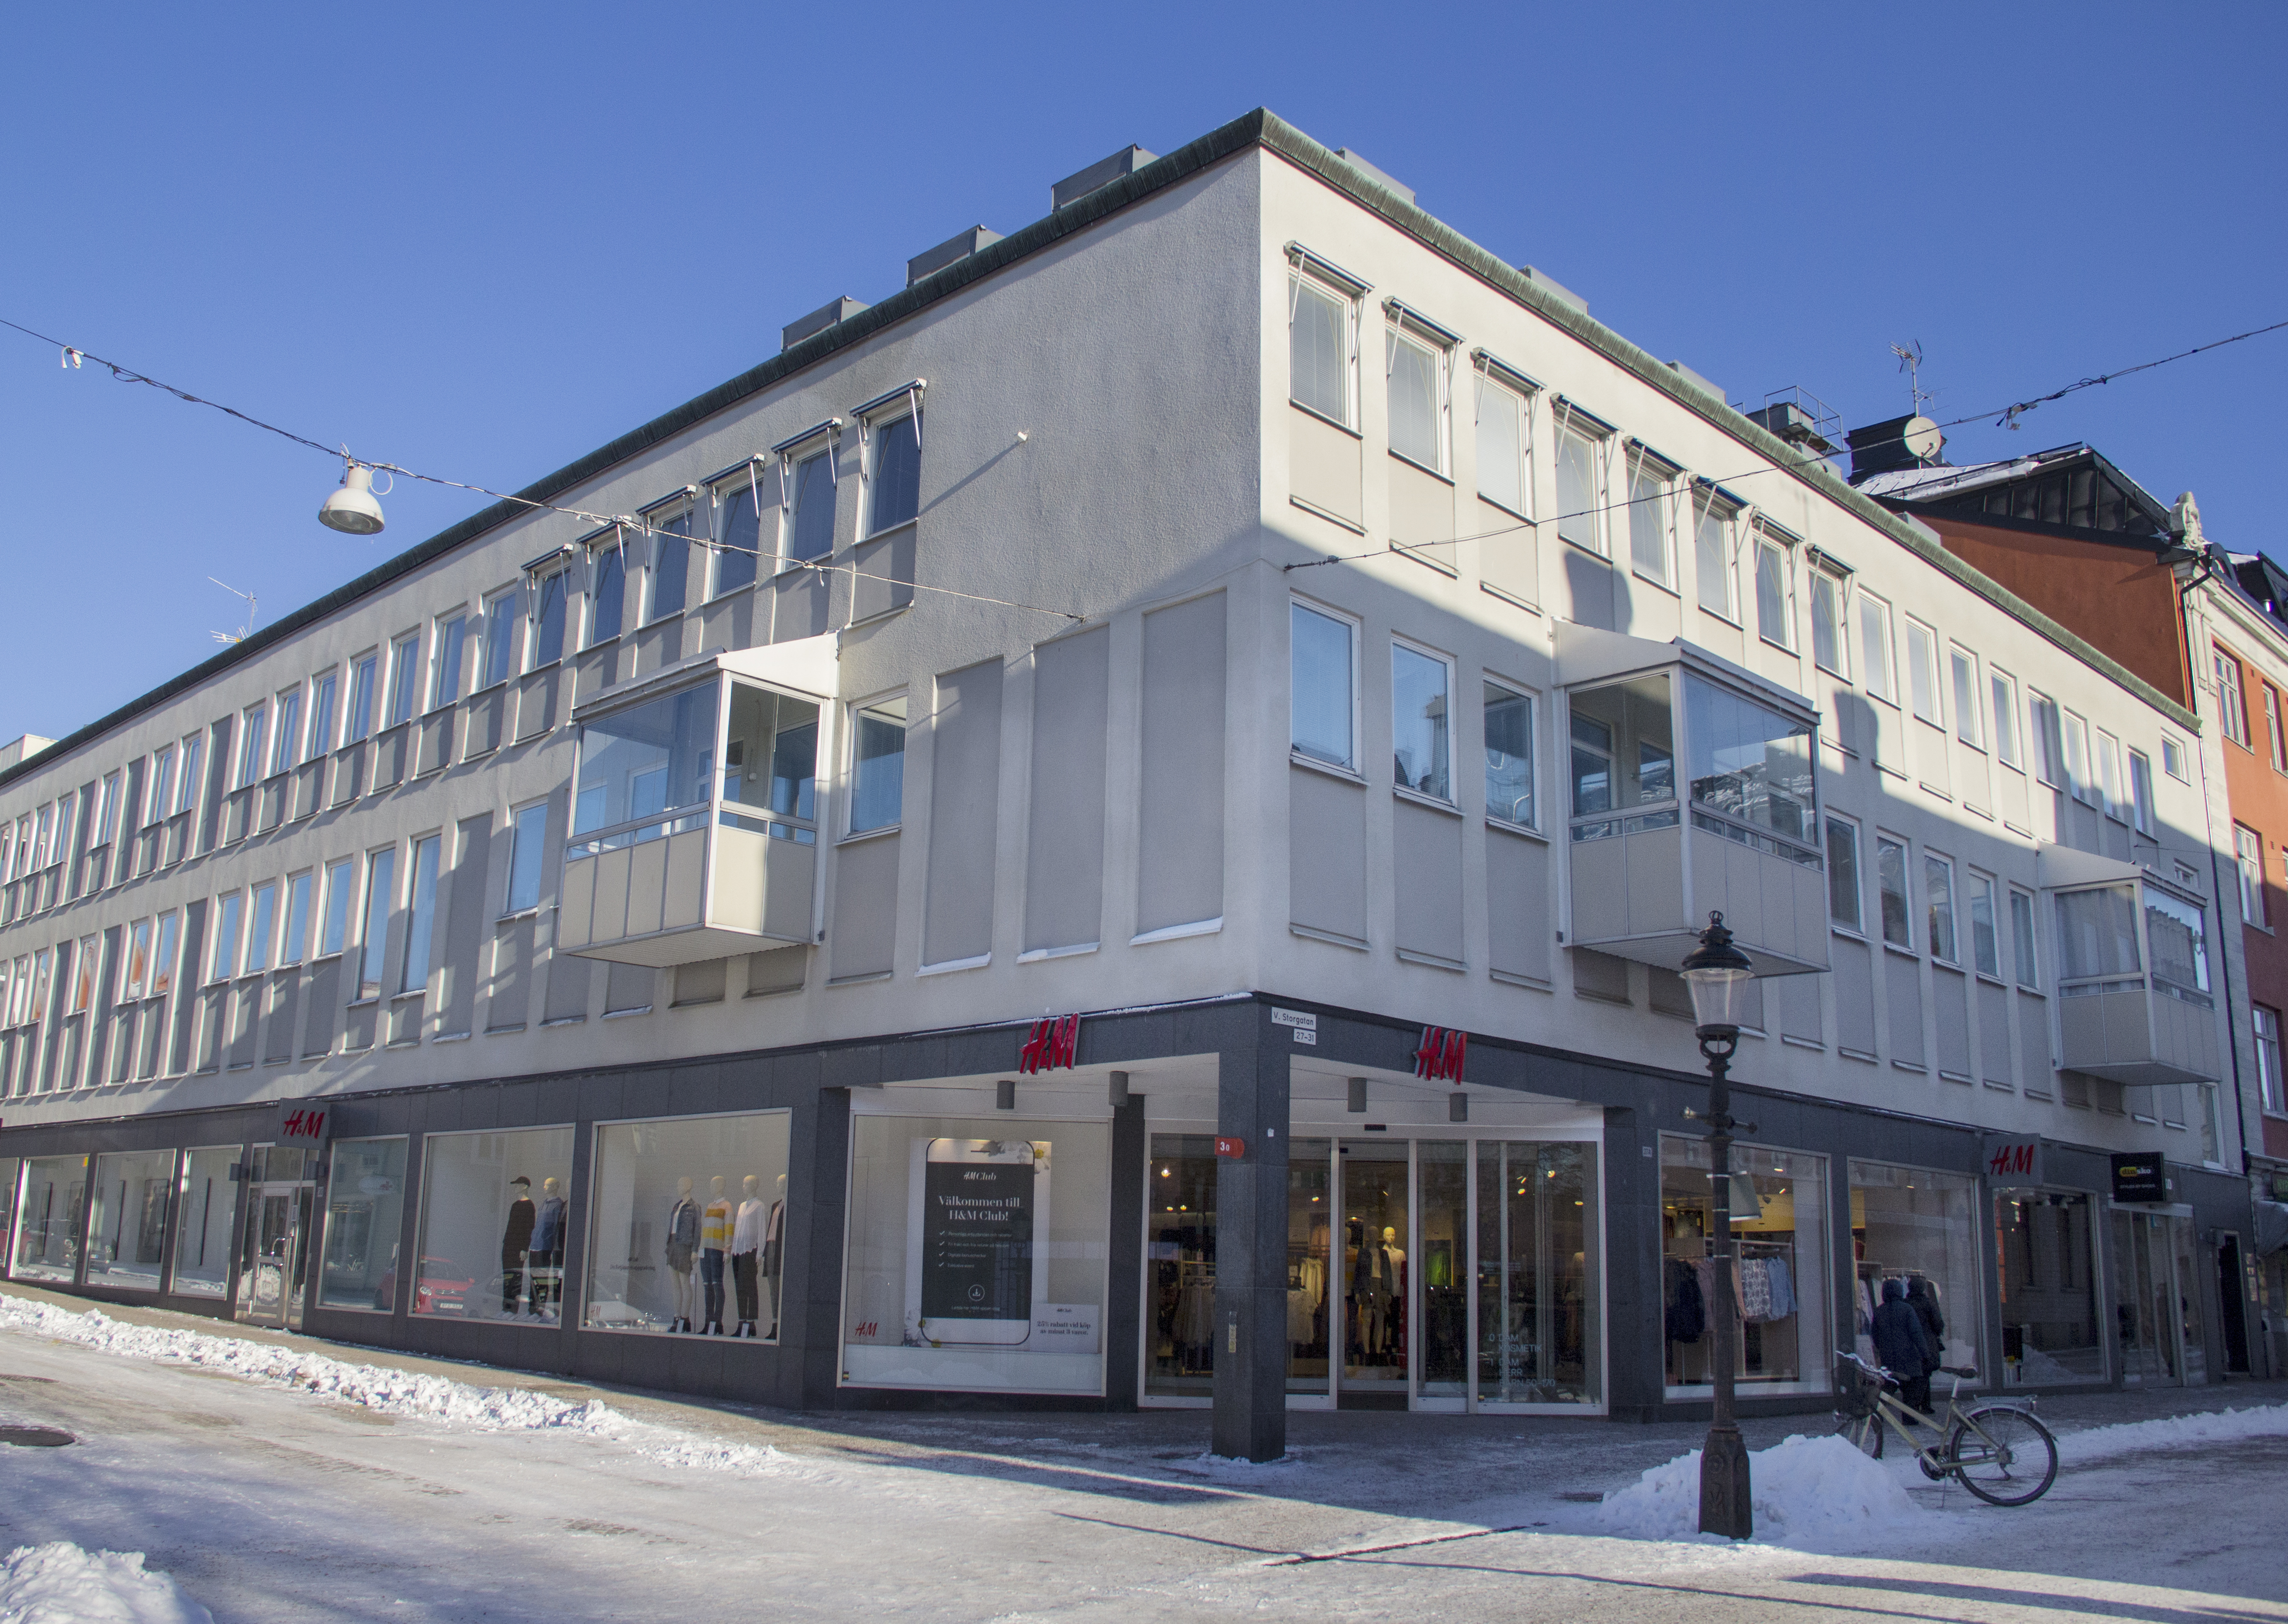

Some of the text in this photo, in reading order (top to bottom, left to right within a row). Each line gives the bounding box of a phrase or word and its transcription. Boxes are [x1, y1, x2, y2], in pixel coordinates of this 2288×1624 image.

[1274, 1011, 1314, 1025] V. Storgatan
[1019, 1013, 1080, 1075] H&M
[1296, 1032, 1314, 1042] 27-31
[1413, 1026, 1468, 1086] H&M
[283, 1109, 325, 1139] H&M
[1990, 1144, 2034, 1176] H&M
[976, 1172, 996, 1181] Club
[938, 1195, 1021, 1207] Välkommen till
[949, 1210, 1009, 1221] H&M Club!
[855, 1322, 878, 1338] H&M
